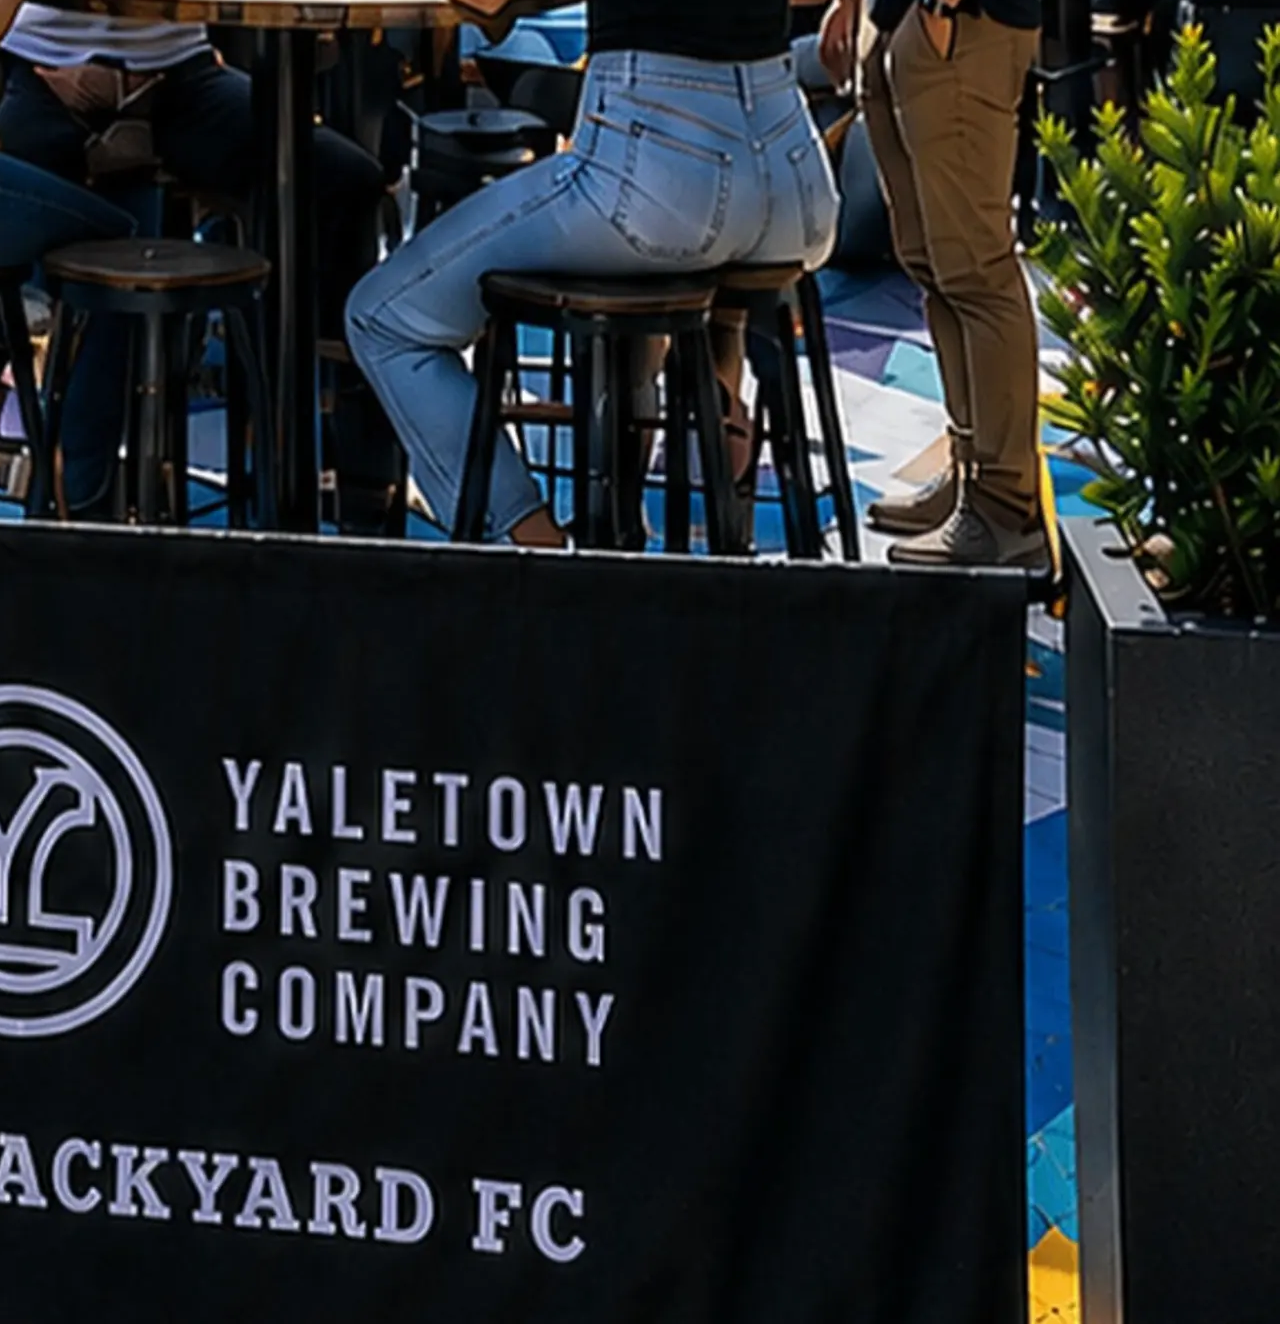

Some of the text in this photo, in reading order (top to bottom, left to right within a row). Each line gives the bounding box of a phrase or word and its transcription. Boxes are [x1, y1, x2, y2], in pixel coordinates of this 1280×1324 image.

[223, 758, 661, 860] YALETOWN
[223, 860, 605, 962] BREWING
[222, 961, 614, 1066] COMPANY
[472, 1178, 585, 1262] FC
